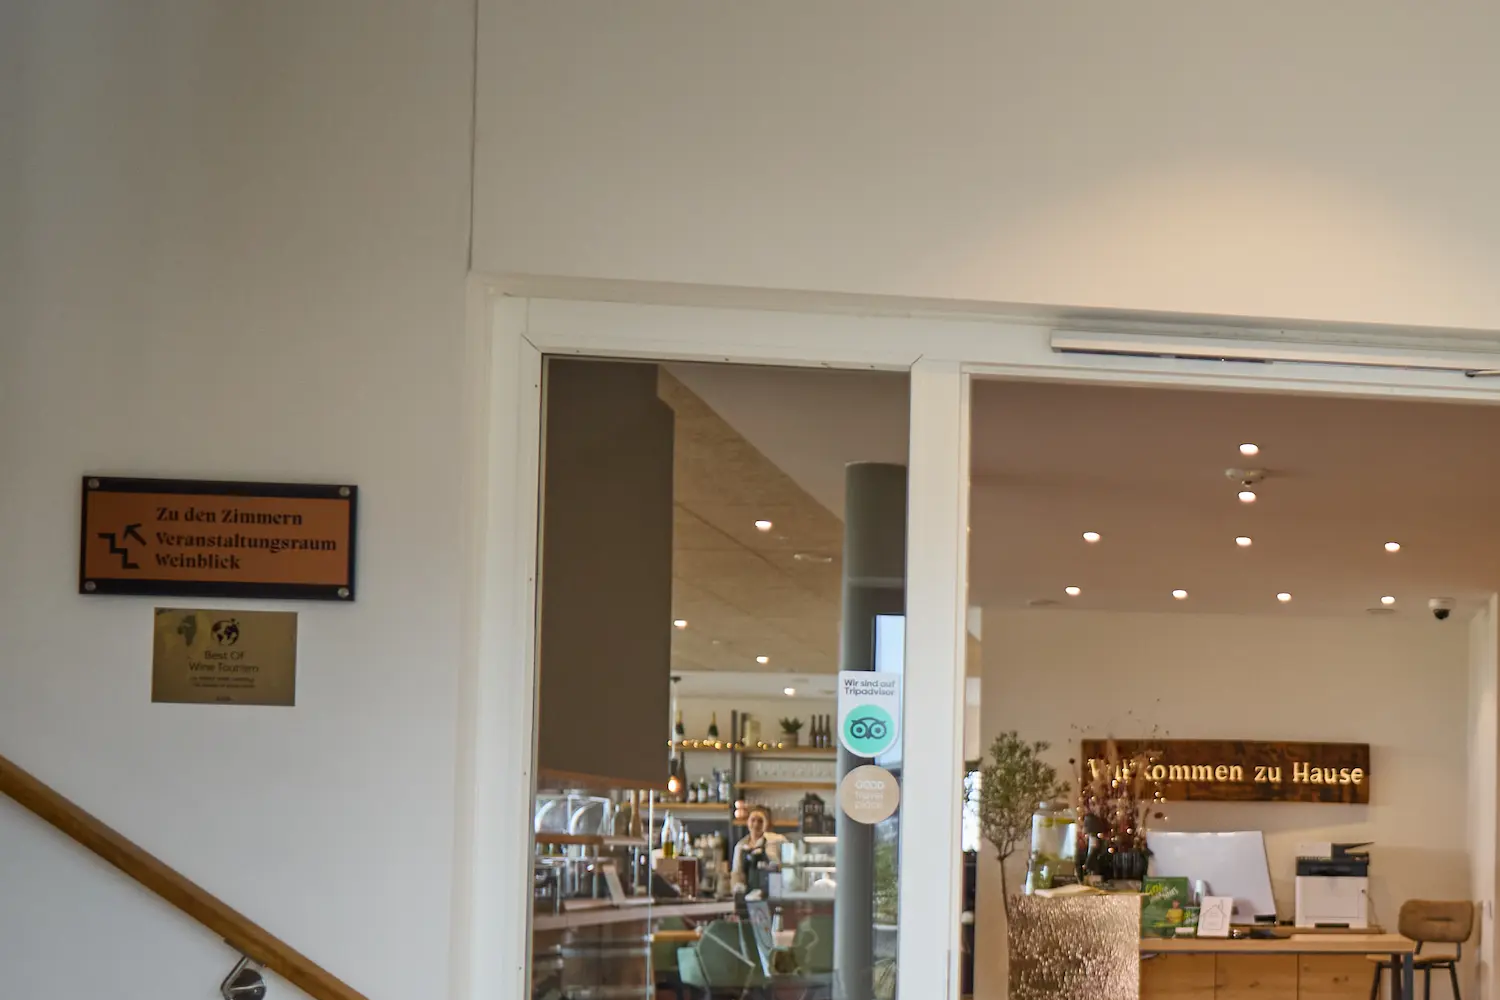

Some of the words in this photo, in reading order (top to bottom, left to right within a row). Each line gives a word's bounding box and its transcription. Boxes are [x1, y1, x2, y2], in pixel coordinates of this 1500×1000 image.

[156, 507, 179, 522] Zu
[184, 507, 216, 523] den
[221, 509, 303, 526] Zimmern
[155, 532, 337, 554] Veranstaltungsraum
[155, 553, 241, 569] Weinblick
[204, 650, 228, 660] Best
[189, 661, 216, 672] Wine
[218, 662, 260, 673] Tourism
[844, 679, 858, 687] Wir
[880, 680, 896, 688] auf
[844, 687, 894, 696] Tripadvisor
[1088, 757, 1243, 783] Wllommen
[1254, 766, 1281, 783] zu
[1292, 762, 1365, 785] Hause
[854, 780, 885, 790] GOOD
